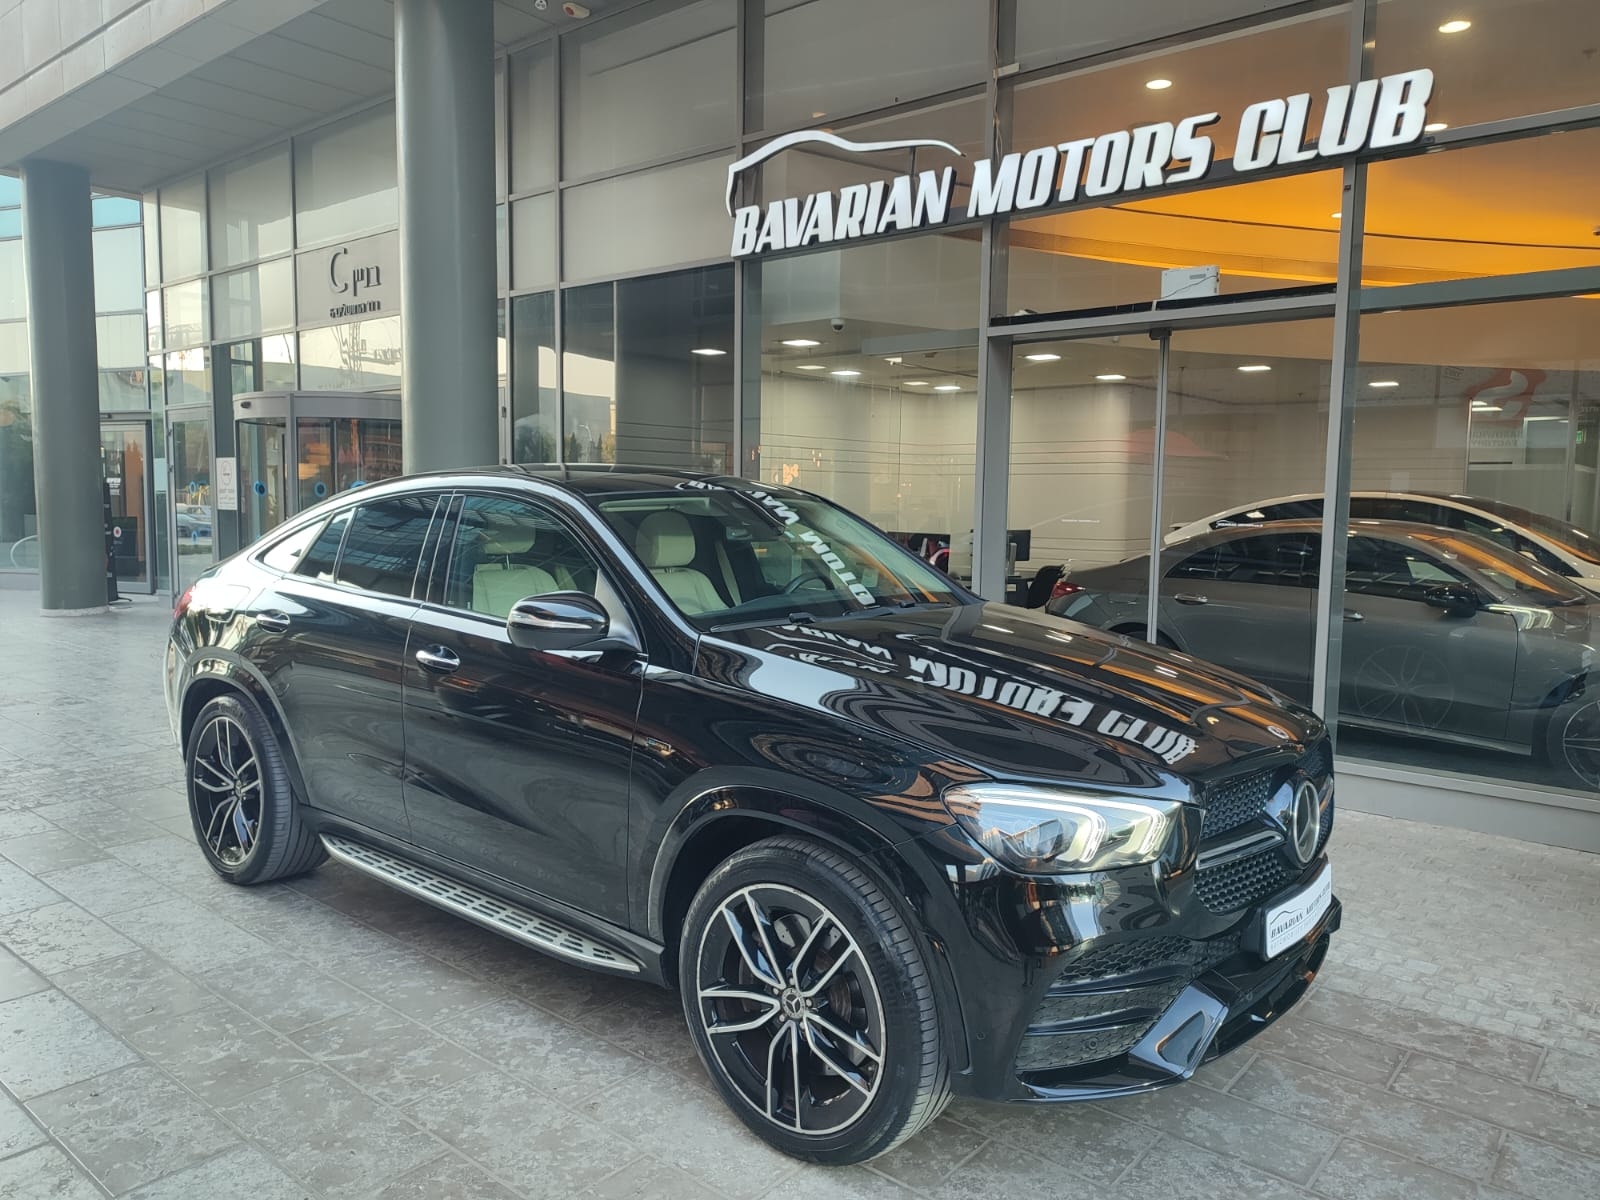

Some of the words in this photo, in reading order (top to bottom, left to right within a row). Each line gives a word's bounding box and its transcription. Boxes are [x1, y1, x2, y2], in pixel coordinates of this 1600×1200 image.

[731, 166, 955, 258] BAVARIAN
[967, 112, 1220, 218] MOTORS
[1233, 68, 1434, 172] CLUB
